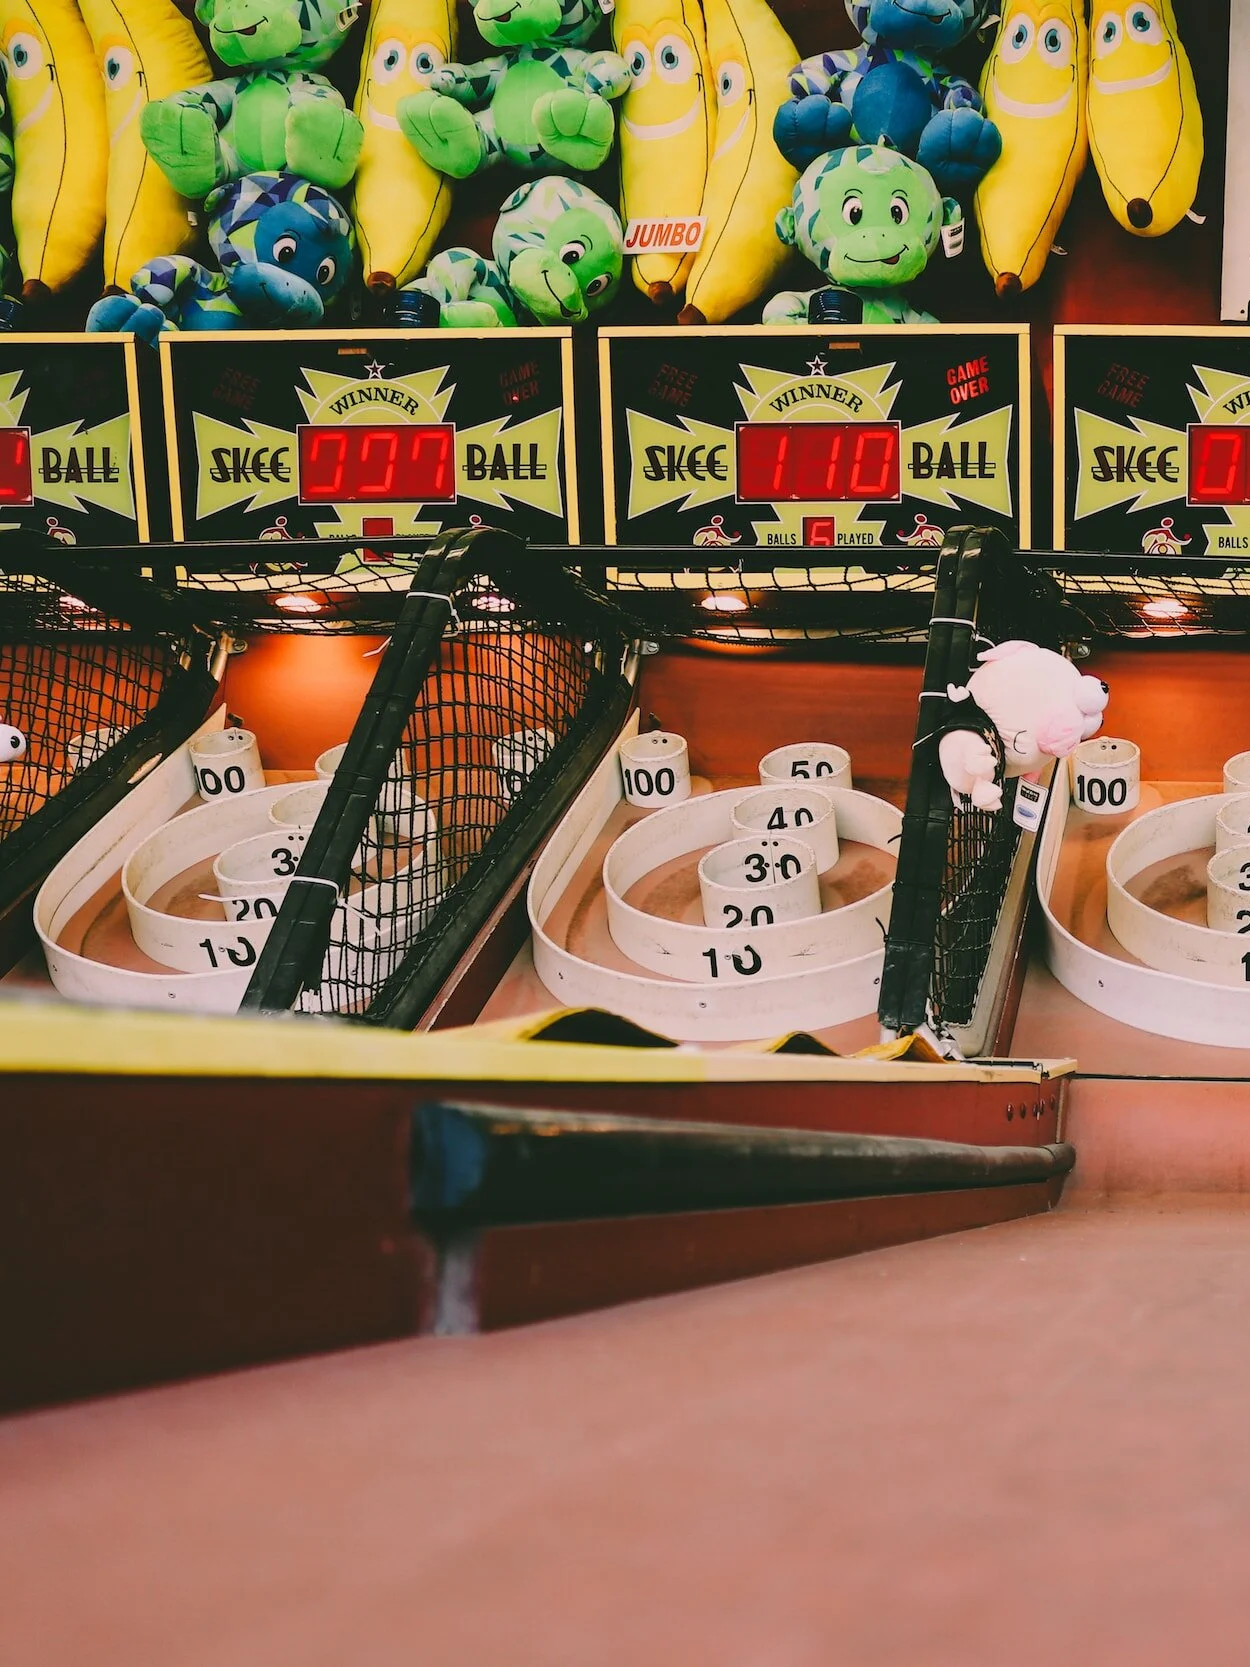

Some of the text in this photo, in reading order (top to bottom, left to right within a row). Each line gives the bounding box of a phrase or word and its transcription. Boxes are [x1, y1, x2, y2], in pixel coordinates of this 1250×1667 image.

[625, 221, 702, 248] JUMBO
[946, 355, 990, 387] GAME
[328, 386, 419, 417] WINNER
[768, 383, 865, 413] WINNER
[949, 376, 990, 405] OVER
[40, 447, 119, 483] BALL
[210, 447, 291, 483] SKEE
[463, 444, 547, 481] BALL
[643, 444, 728, 482] SKEE
[773, 432, 894, 493] 110
[909, 442, 995, 479] BALL
[1092, 445, 1179, 483] SKEE
[767, 533, 797, 545] BALLS
[837, 533, 874, 544] PLAYED
[1218, 536, 1249, 549] BALLS
[624, 768, 675, 797] 100
[1076, 774, 1127, 806] 100
[767, 806, 814, 830] 40
[744, 853, 802, 884] 30
[723, 904, 774, 929] 20
[199, 936, 257, 968] 10
[703, 945, 762, 978] 10
